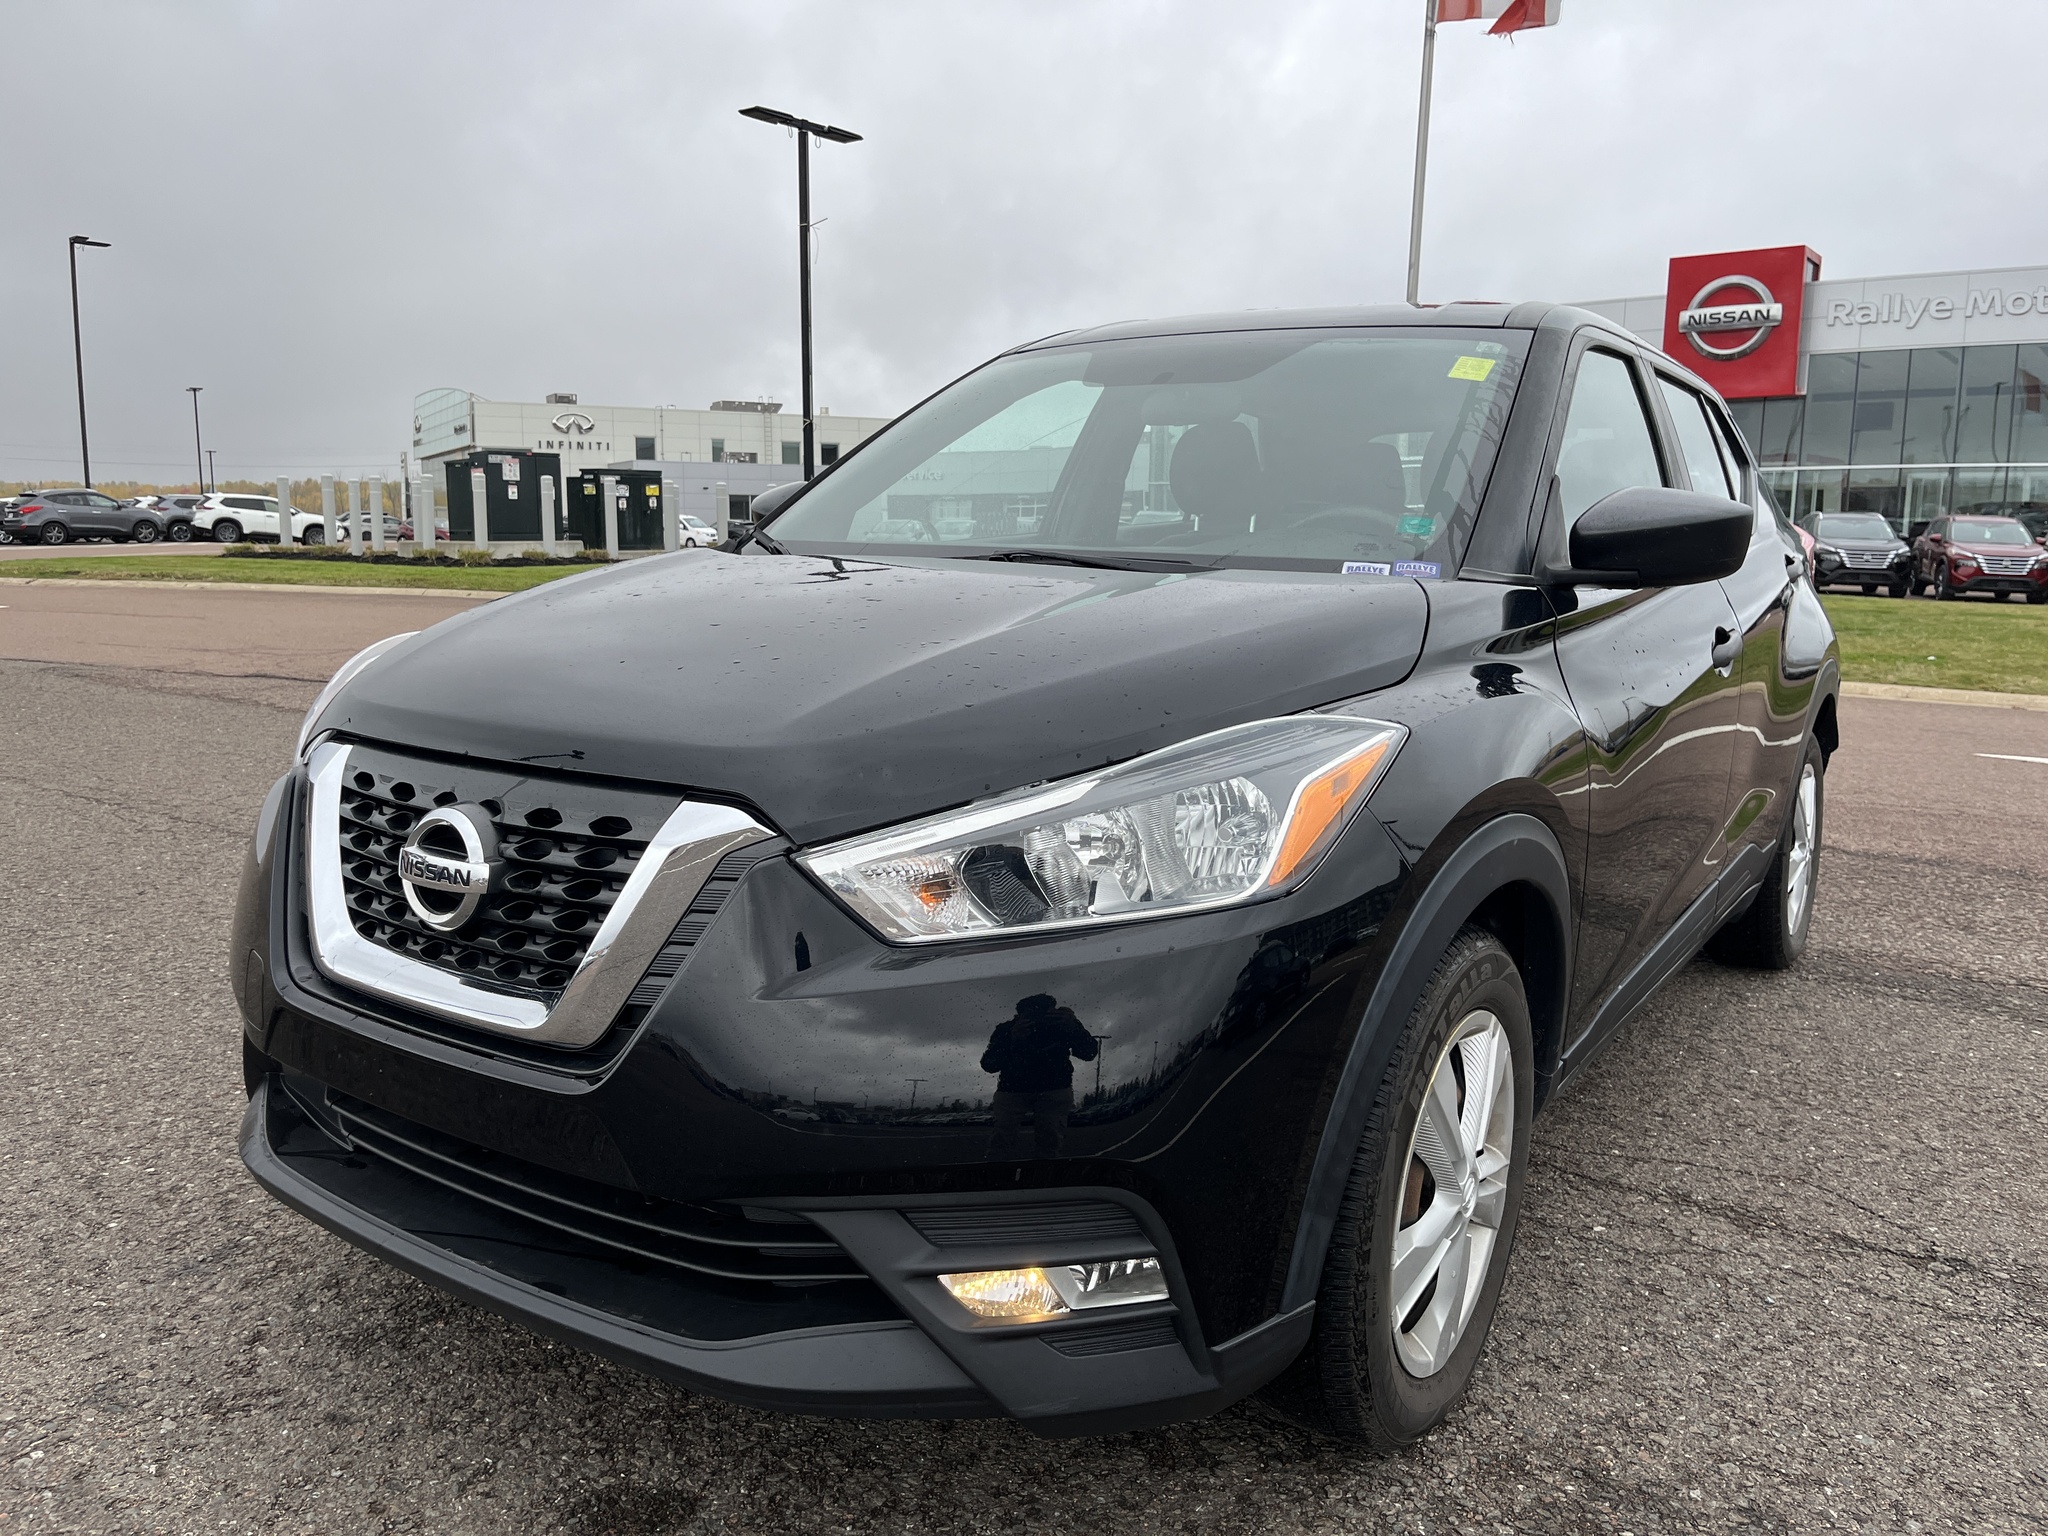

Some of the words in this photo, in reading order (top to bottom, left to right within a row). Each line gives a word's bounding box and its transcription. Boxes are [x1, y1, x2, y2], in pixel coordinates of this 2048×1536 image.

[1687, 309, 1770, 326] NISSAN
[1827, 292, 1954, 329] Rallye
[538, 440, 610, 452] INFINITI
[1346, 564, 1386, 574] RALLYE
[1397, 563, 1436, 574] RALLYE
[400, 855, 472, 887] NISSAN
